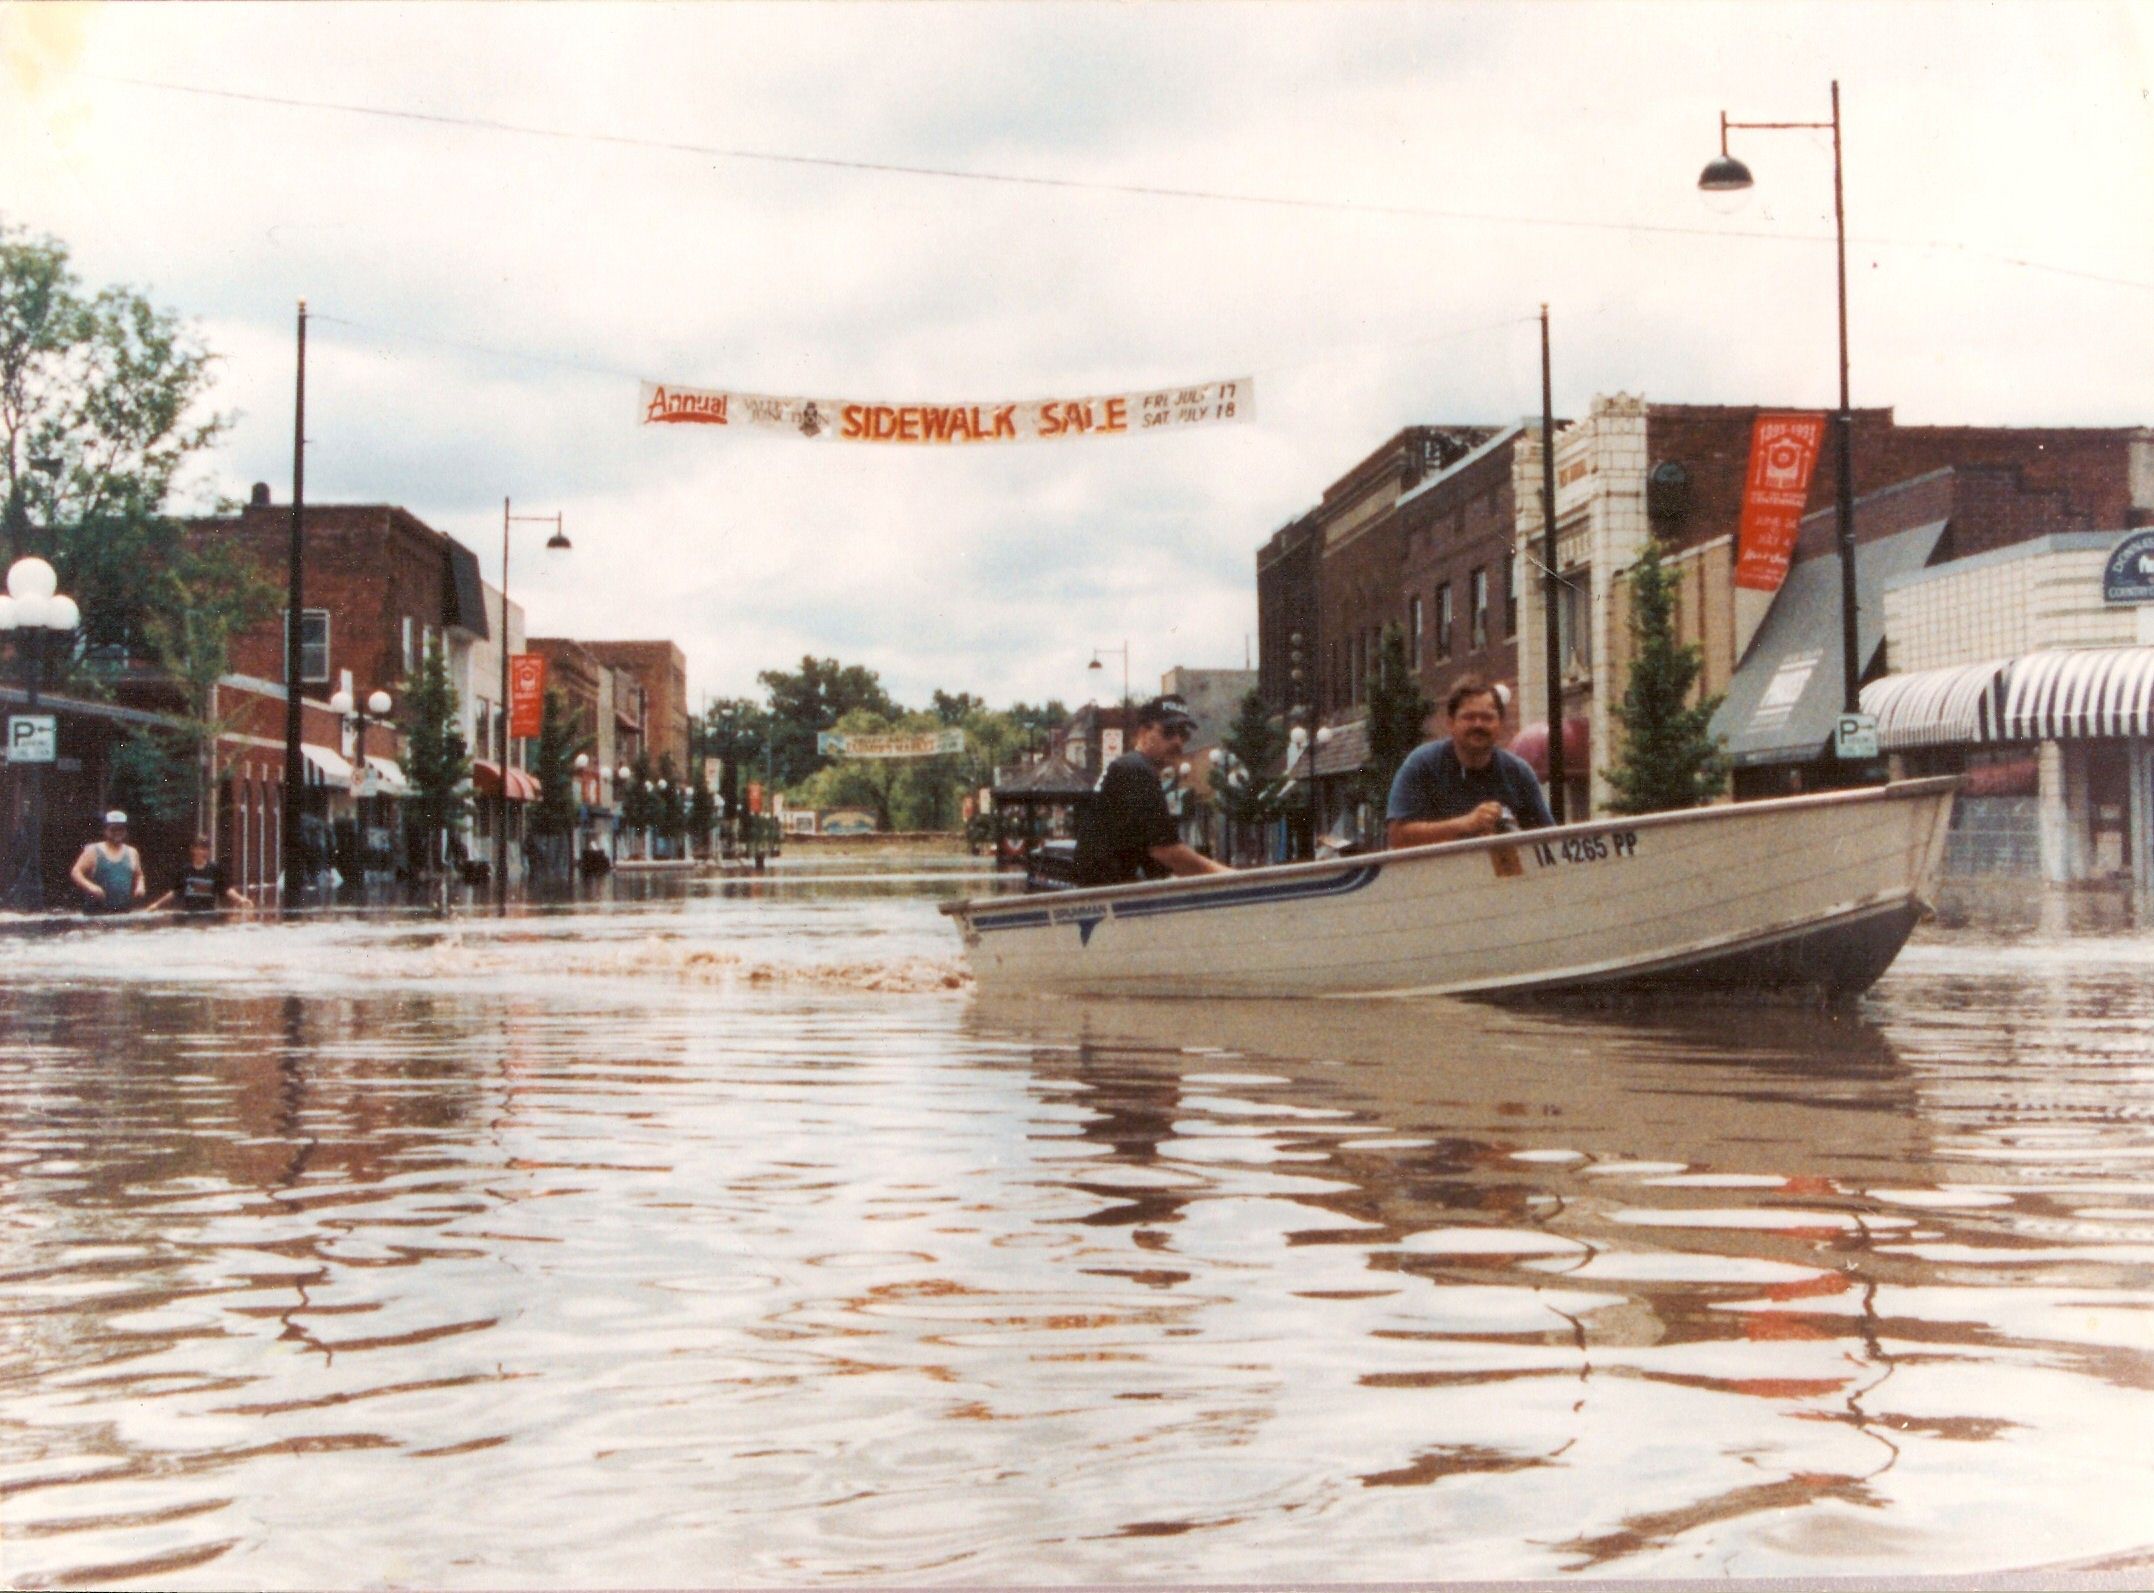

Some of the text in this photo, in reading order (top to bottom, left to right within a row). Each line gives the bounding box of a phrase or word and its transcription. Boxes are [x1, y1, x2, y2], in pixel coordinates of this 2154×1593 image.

[645, 385, 728, 422] Annual
[1143, 393, 1169, 409] FRI
[1218, 383, 1237, 399] 17
[841, 398, 1128, 443] SIDEWALK SALE
[1142, 410, 1170, 428] SAT
[1216, 401, 1236, 419] 18
[1533, 831, 1638, 867] IA 4265 PP
